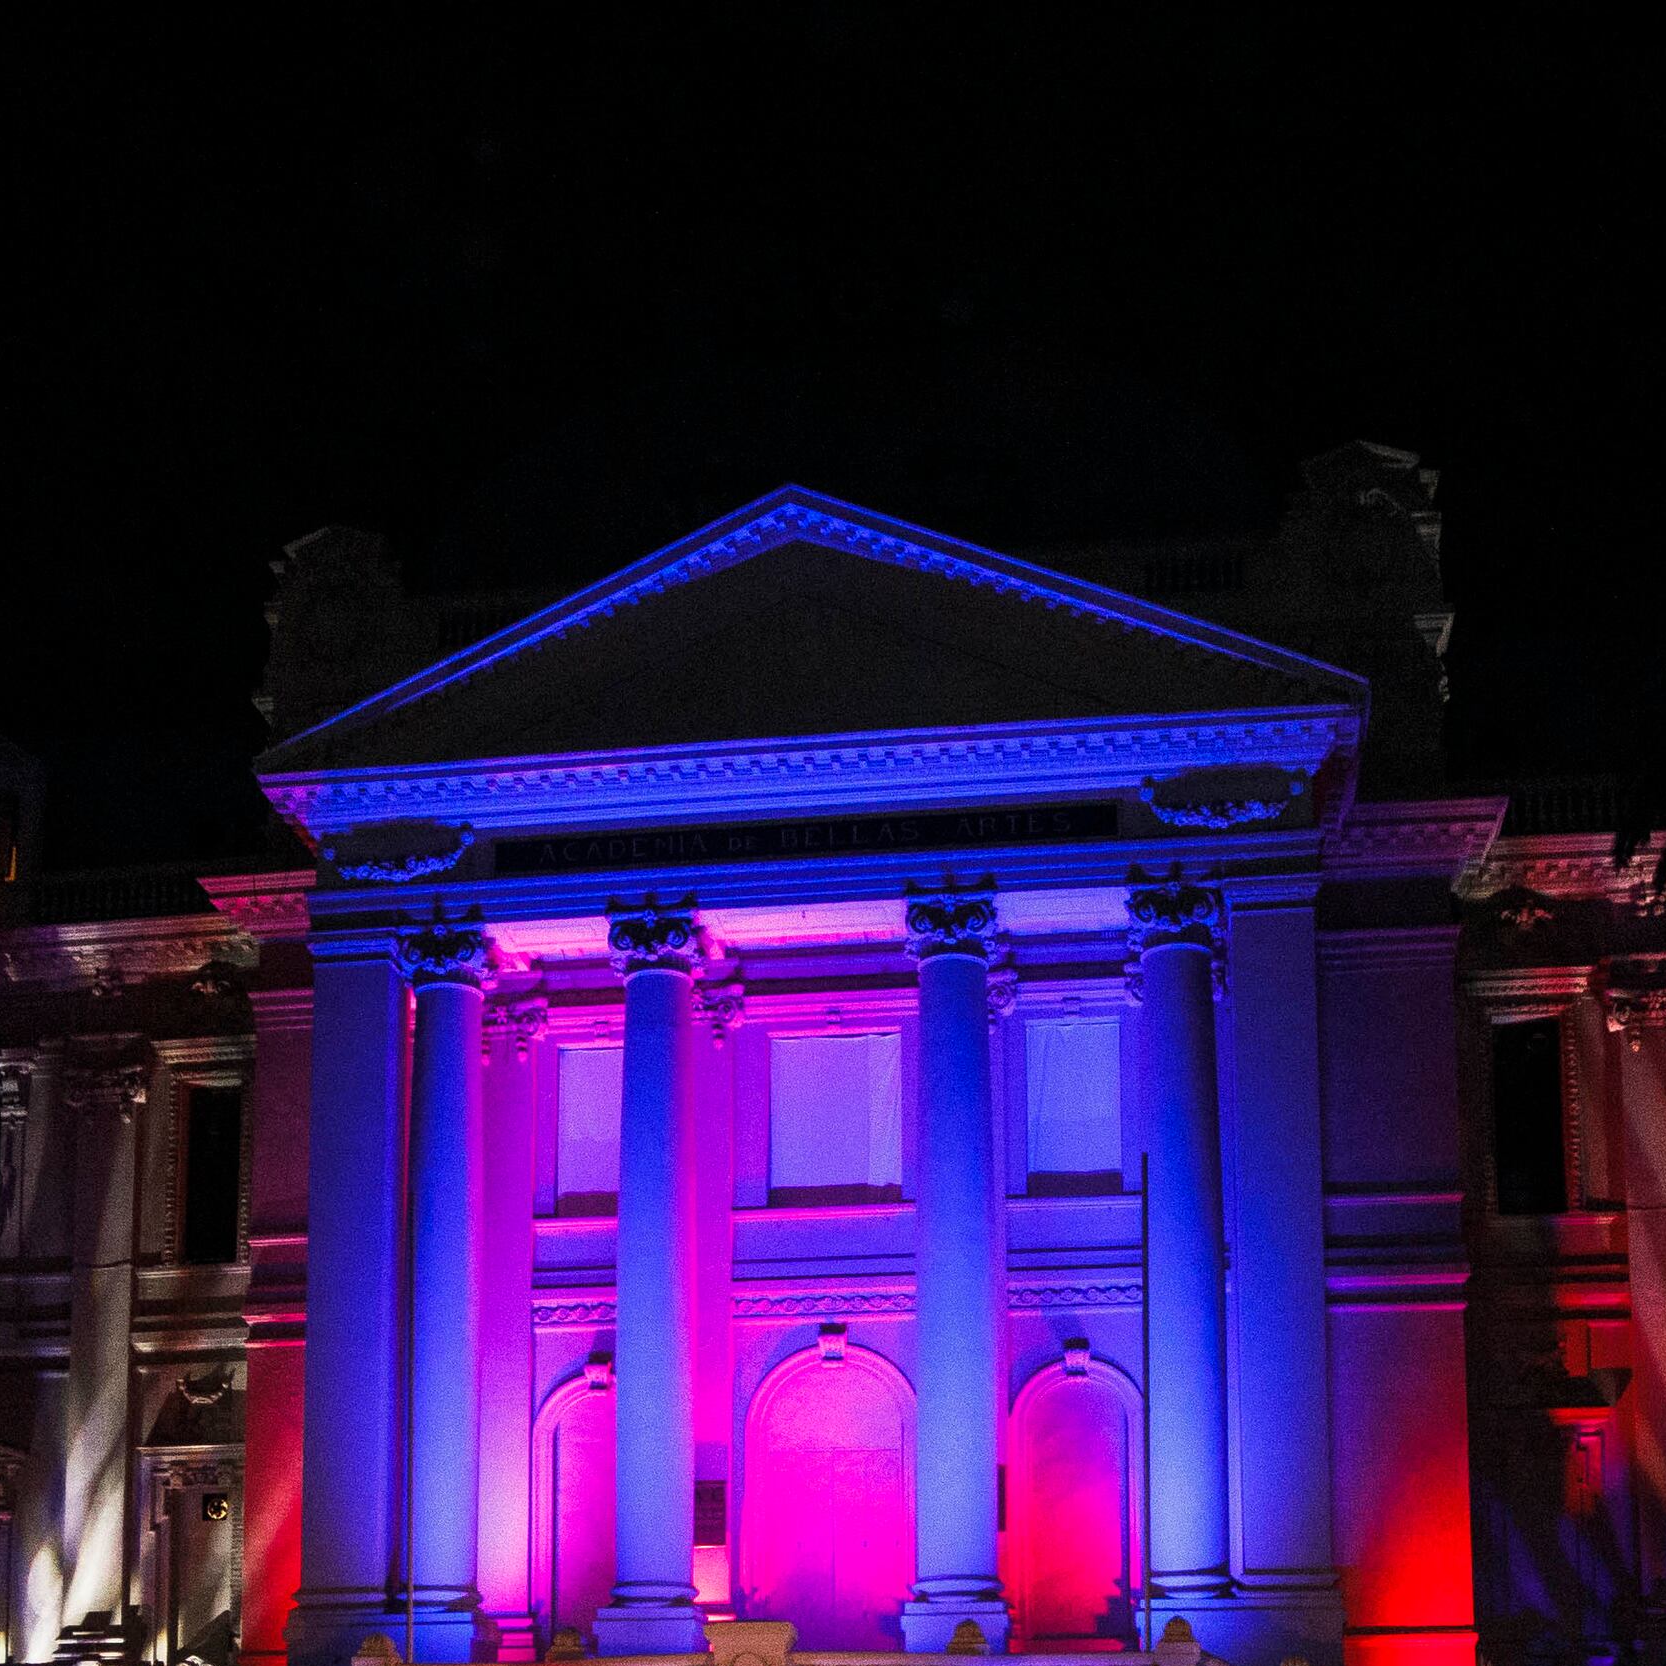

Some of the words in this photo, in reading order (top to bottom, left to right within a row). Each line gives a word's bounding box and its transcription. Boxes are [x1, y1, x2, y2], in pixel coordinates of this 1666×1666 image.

[538, 833, 708, 865] ACADEMIA
[779, 819, 921, 849] BELLAS
[954, 810, 1072, 838] ARTES
